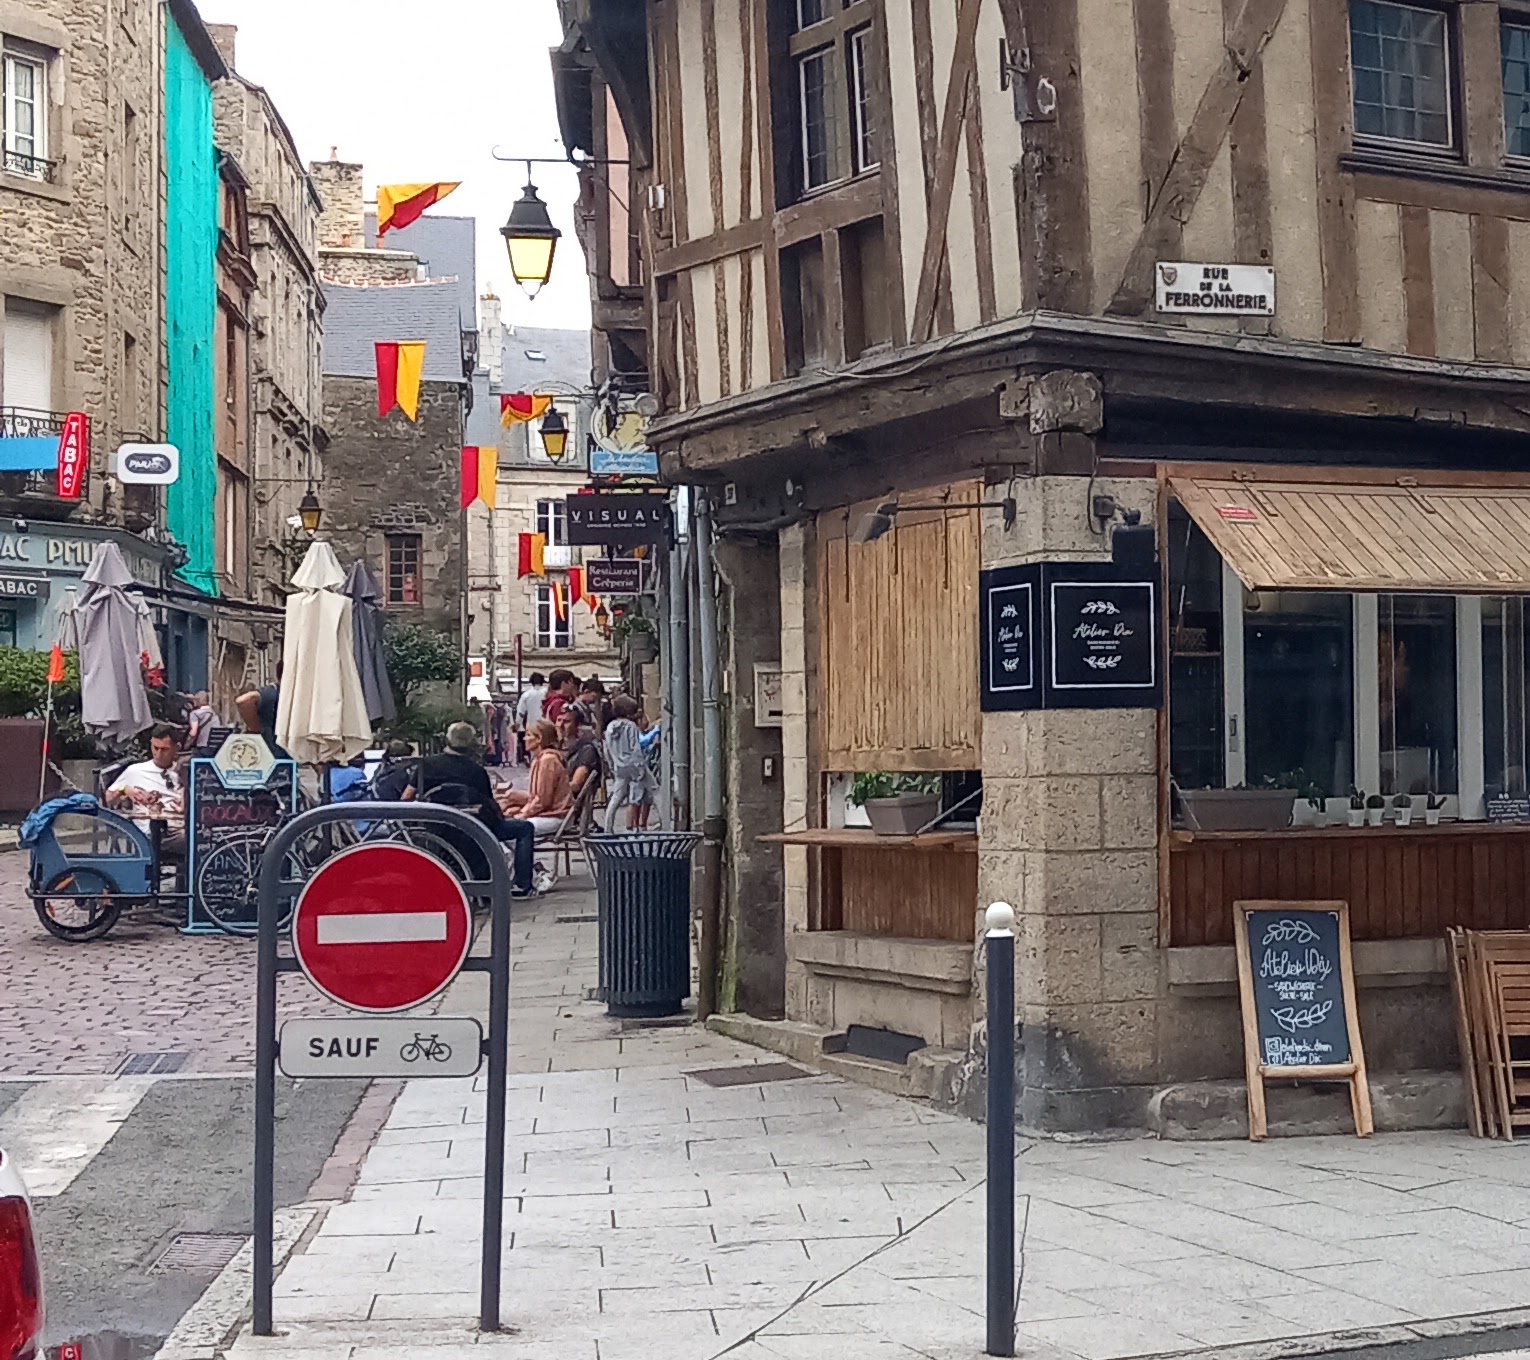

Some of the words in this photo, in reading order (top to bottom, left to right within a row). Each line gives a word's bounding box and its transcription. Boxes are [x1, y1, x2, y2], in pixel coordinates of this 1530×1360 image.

[1203, 267, 1228, 280] RUE
[1199, 282, 1212, 291] DE
[1219, 283, 1232, 292] LA
[1165, 292, 1267, 310] FERRONNERIE
[63, 421, 77, 489] TABAC
[571, 509, 660, 522] VISUAL
[1072, 621, 1110, 639] Atelier
[1260, 947, 1305, 978] Atelier
[308, 1037, 380, 1058] SAUF
